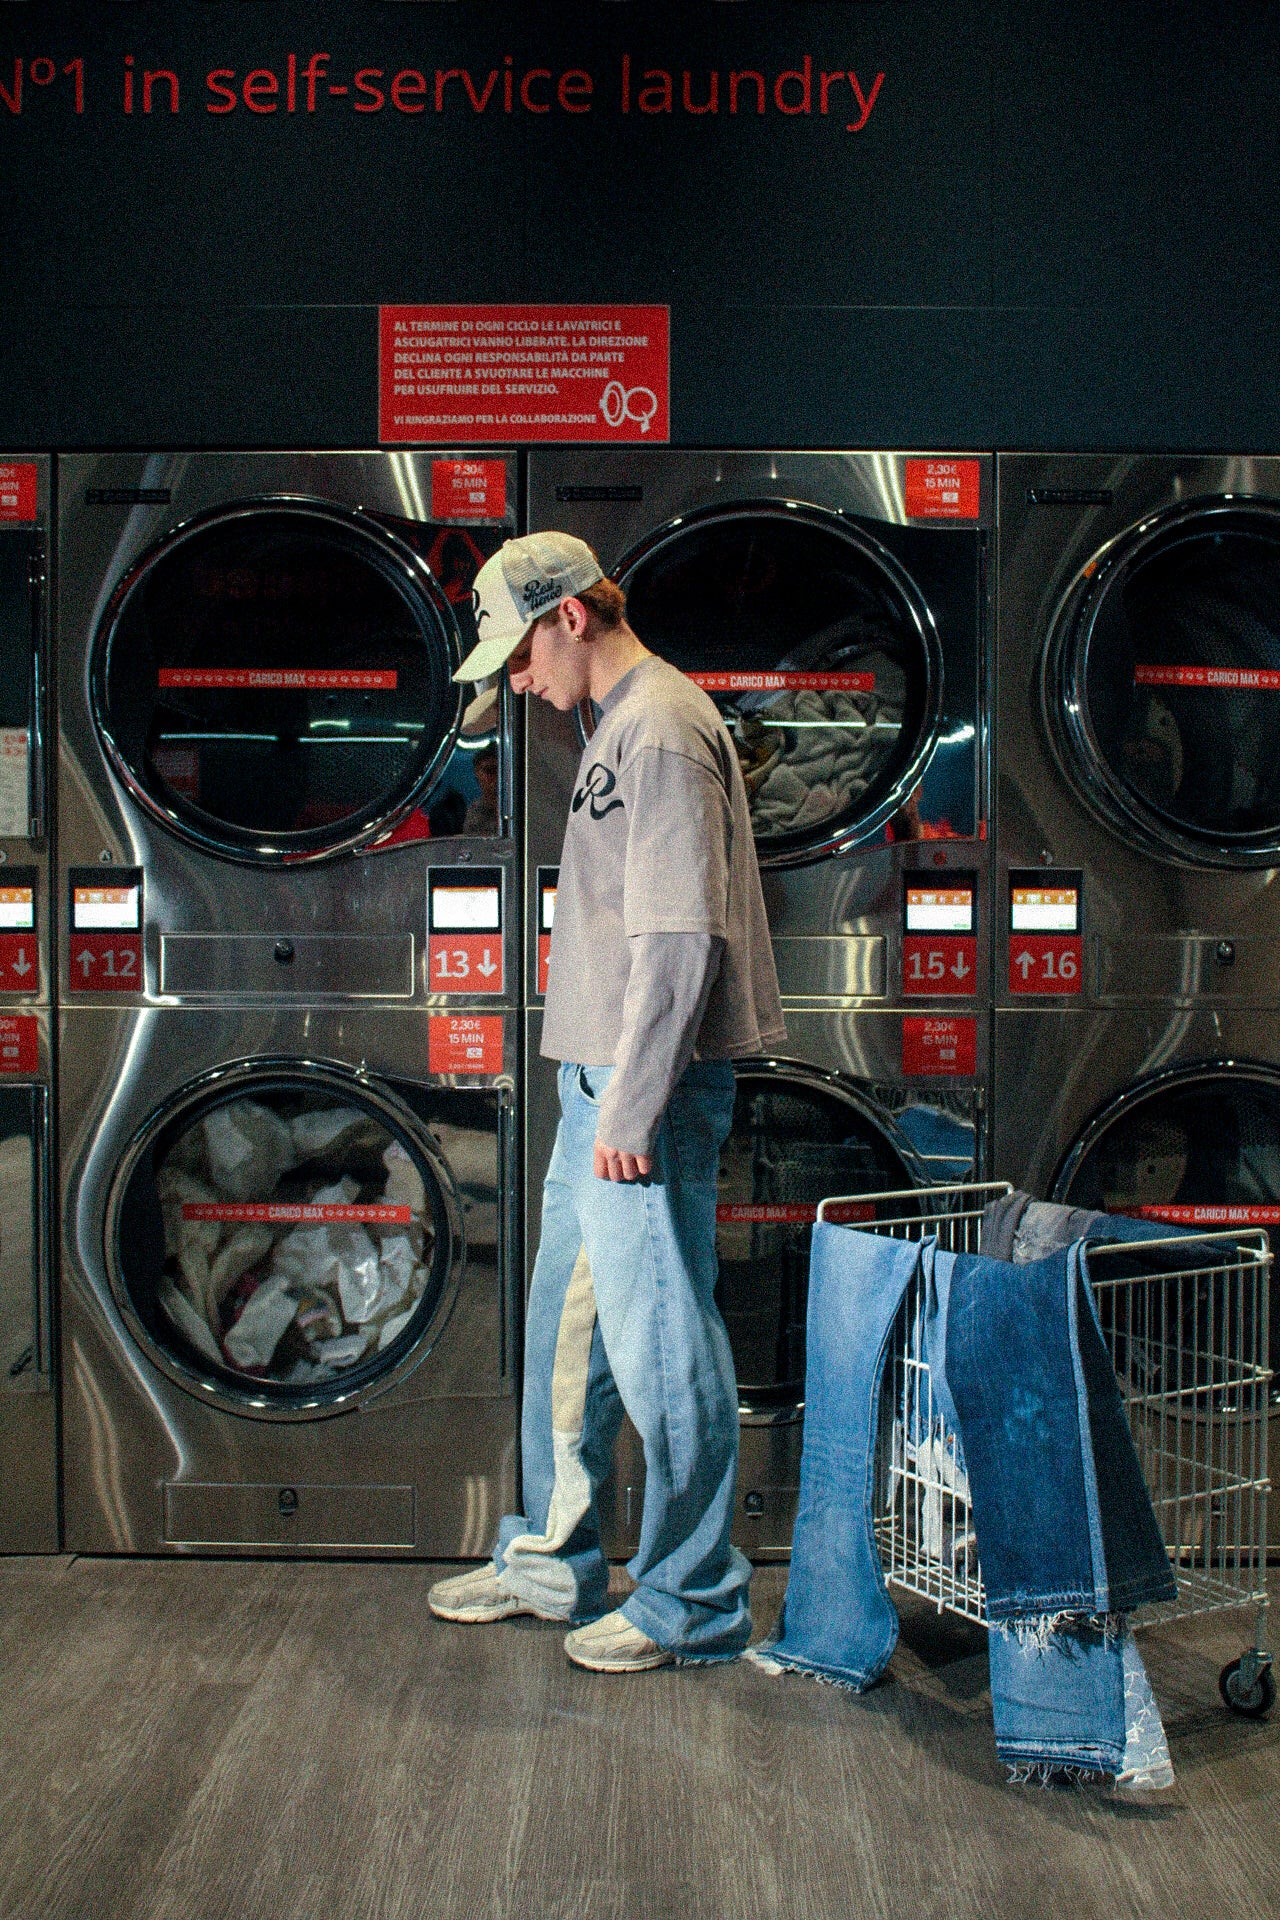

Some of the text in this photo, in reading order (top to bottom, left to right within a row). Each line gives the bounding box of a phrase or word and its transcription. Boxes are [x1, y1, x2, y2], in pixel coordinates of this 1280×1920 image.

[124, 55, 180, 114] in
[206, 53, 595, 114] self-service
[622, 54, 886, 132] laundry
[394, 320, 621, 331] AL TERMINE DI OGNI CICLO LE LAVATRICI E
[394, 336, 648, 347] ASCIUGATRICI VANNO LIBERATE. LA DIREZIONE
[394, 350, 624, 363] DECLINA OGNI RESPONSABILITÀ DA PARTE
[394, 368, 609, 379] DEL CLIENTE A SVUOTARE LE MACCHINE
[394, 384, 558, 395] PER USUFRUIRE DEL SERVIZIO.
[394, 414, 596, 424] VI RINGRAZIAMO PER LA COLLABORAZIONE
[464, 478, 487, 488] MIN
[925, 478, 960, 488] 15 MIN
[250, 673, 305, 684] CARICO MAX
[730, 676, 786, 687] CARICO MAX
[1207, 671, 1259, 684] CARICO MAX
[102, 950, 136, 977] 12
[435, 950, 470, 978] 13
[908, 952, 945, 980] 15
[1041, 952, 1077, 979] 16
[449, 1033, 485, 1044] 15 MIN
[922, 1034, 958, 1045] 15 MIN
[303, 1207, 324, 1218] MAX
[731, 1207, 787, 1218] CARICO MAX
[1194, 1209, 1249, 1220] CARICO MAX
